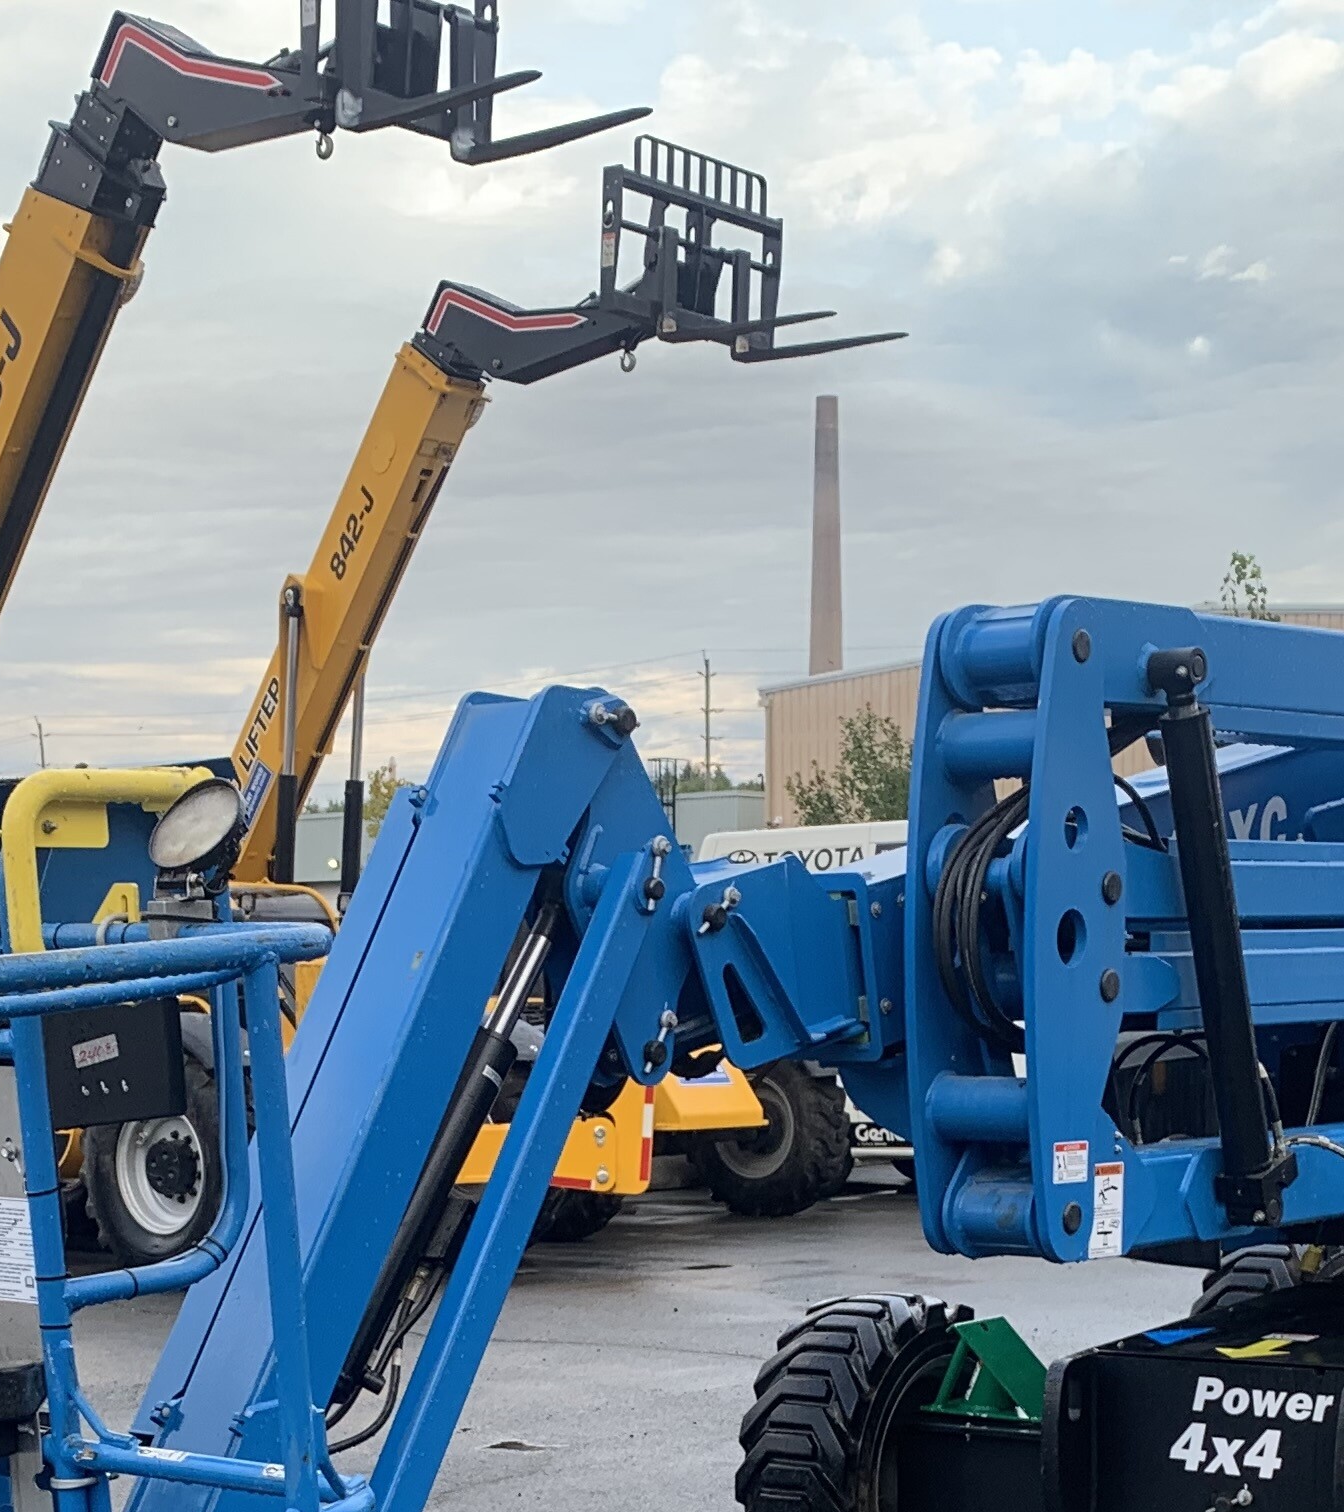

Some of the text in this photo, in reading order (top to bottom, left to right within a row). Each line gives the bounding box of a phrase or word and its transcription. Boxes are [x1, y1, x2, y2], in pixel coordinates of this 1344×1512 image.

[330, 485, 374, 581] 842-J
[1192, 1376, 1335, 1423] Power
[1169, 1422, 1283, 1480] 4x4
